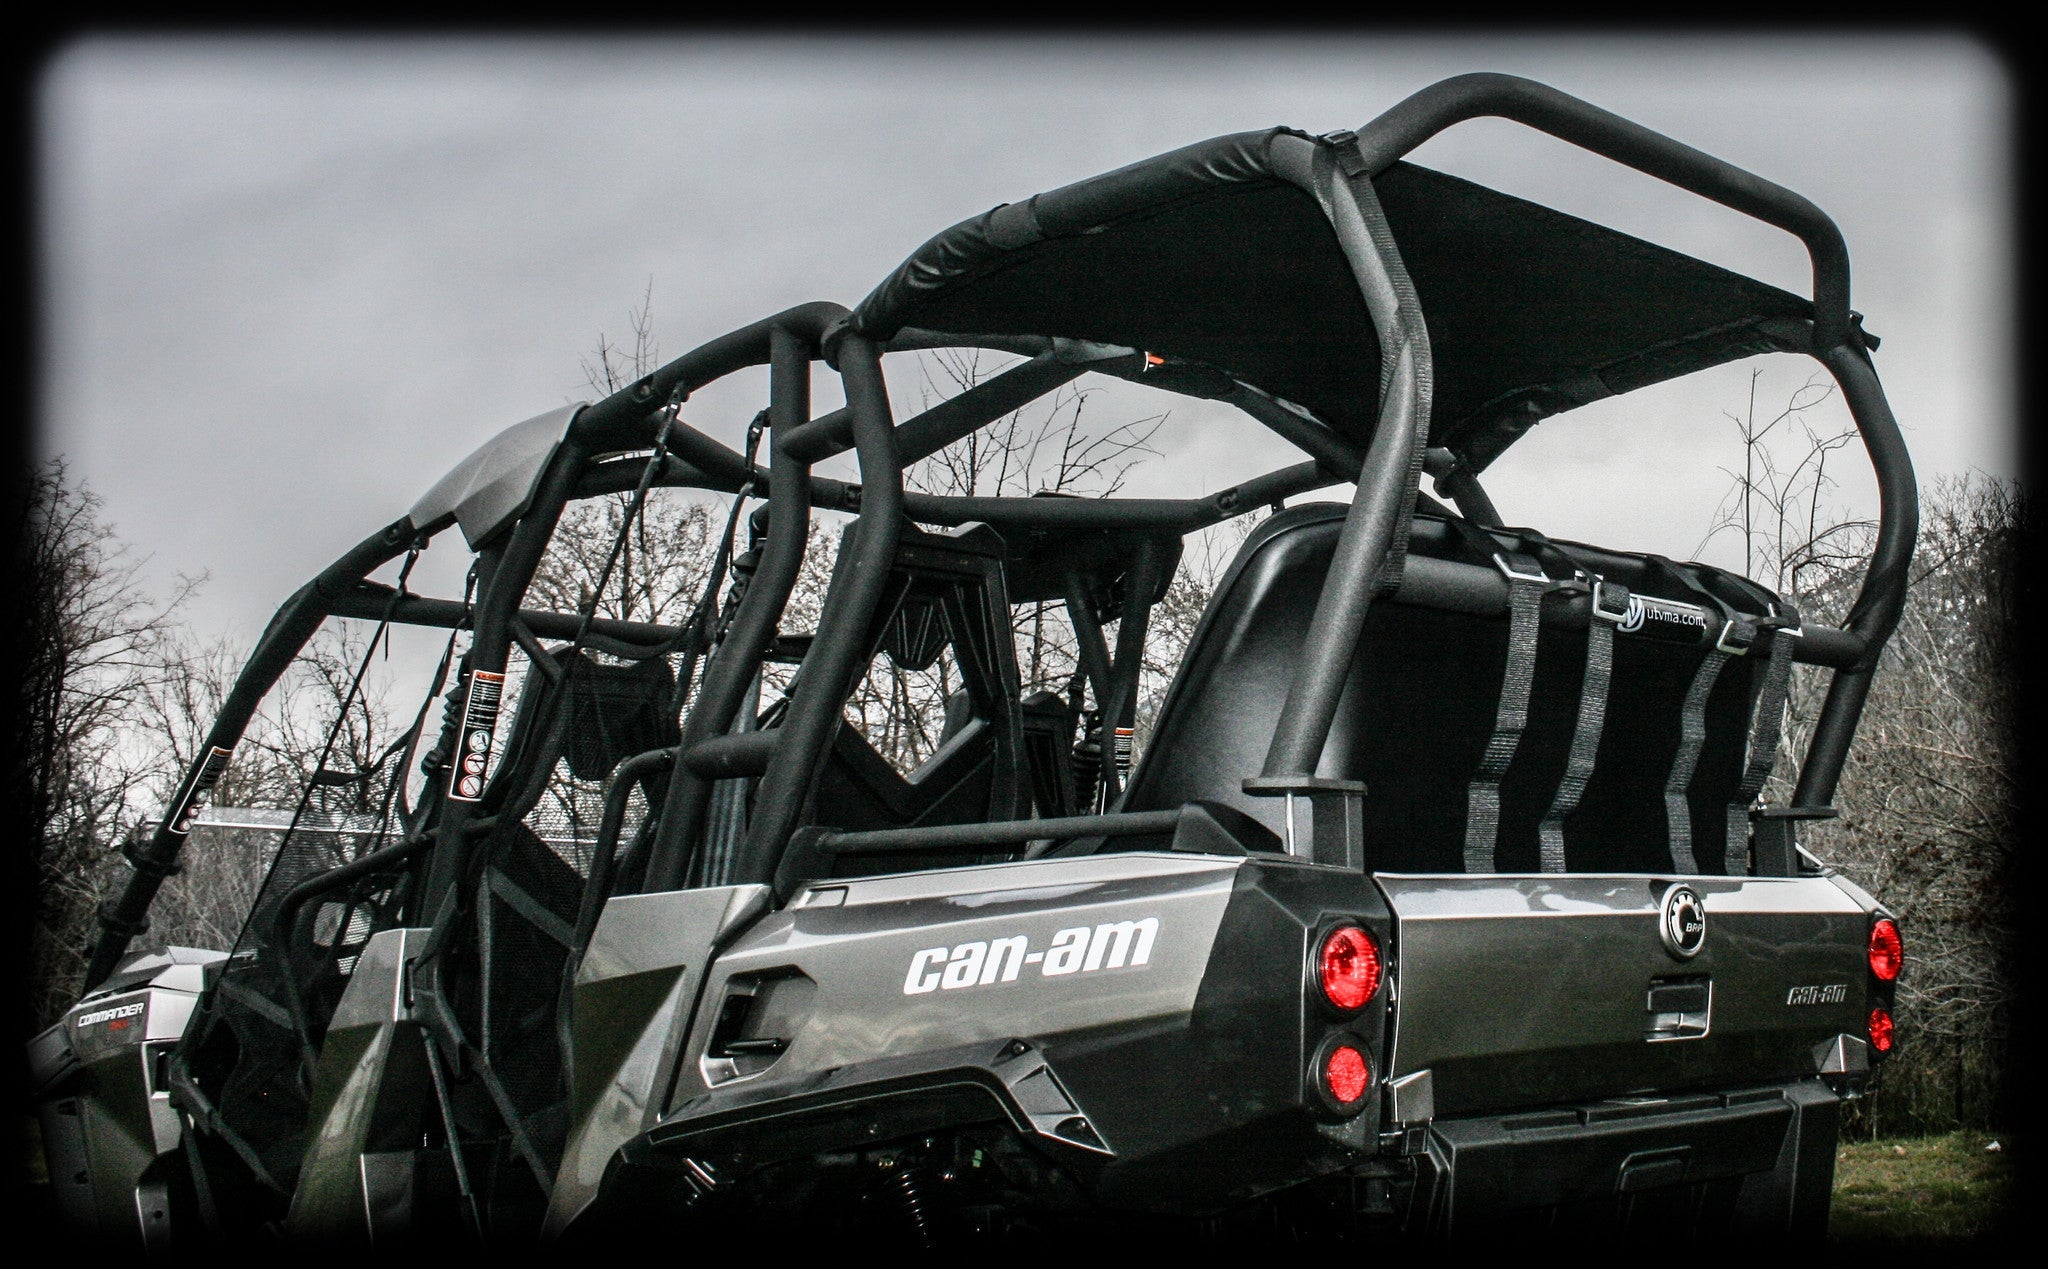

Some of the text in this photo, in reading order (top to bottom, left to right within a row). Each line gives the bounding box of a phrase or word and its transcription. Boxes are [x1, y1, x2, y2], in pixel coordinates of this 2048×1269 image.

[1647, 606, 1704, 626] utvma.com
[1685, 922, 1703, 932] BRP
[903, 917, 1159, 995] can-am
[78, 1002, 144, 1027] COMMANDER
